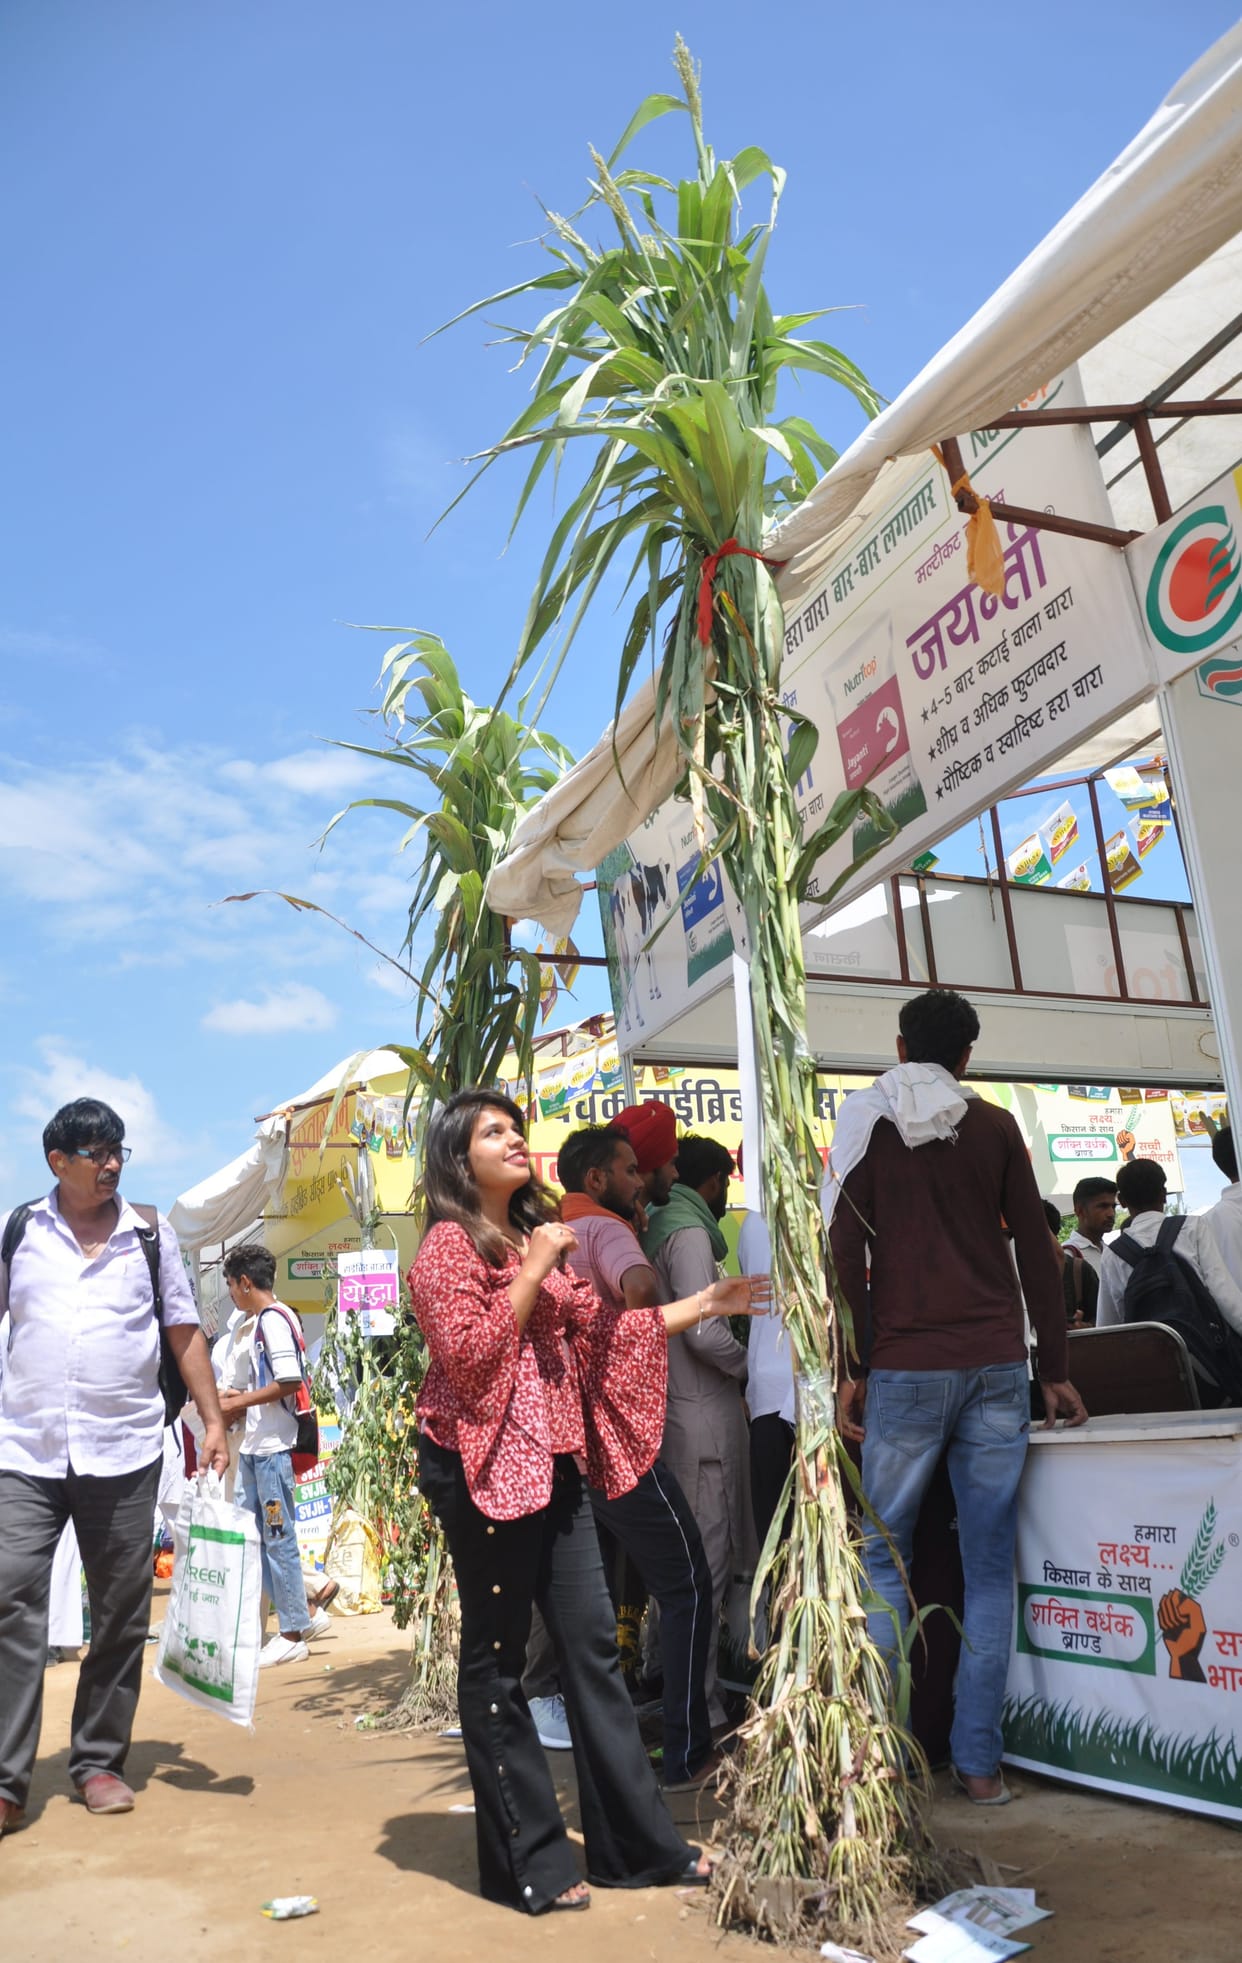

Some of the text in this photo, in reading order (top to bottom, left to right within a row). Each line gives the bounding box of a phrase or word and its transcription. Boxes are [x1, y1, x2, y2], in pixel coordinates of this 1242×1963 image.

[803, 589, 830, 632] चारा
[831, 534, 881, 603] बार-बार
[880, 478, 936, 553] लगातार
[954, 666, 975, 694] बार
[976, 629, 1010, 676] कटाई
[1011, 612, 1043, 647] वाला
[1044, 586, 1074, 621] चारा
[843, 658, 877, 697] Nutritop
[960, 716, 970, 735] व
[973, 686, 1010, 727] अधिक
[1011, 640, 1068, 702] फुटावदार
[942, 752, 983, 793] पौष्टिक
[984, 744, 995, 763] व
[996, 707, 1045, 756] स्वादिष्ट
[1046, 689, 1071, 721] हरा
[1072, 664, 1104, 699] चारा
[808, 793, 825, 815] चारा
[1133, 1524, 1177, 1544] हमारा
[1042, 1560, 1152, 1593] किसान के साथ
[1030, 1597, 1079, 1629] शक्ति
[1084, 1604, 1135, 1638] वर्धक
[1061, 1631, 1102, 1653] ब्राण्ड
